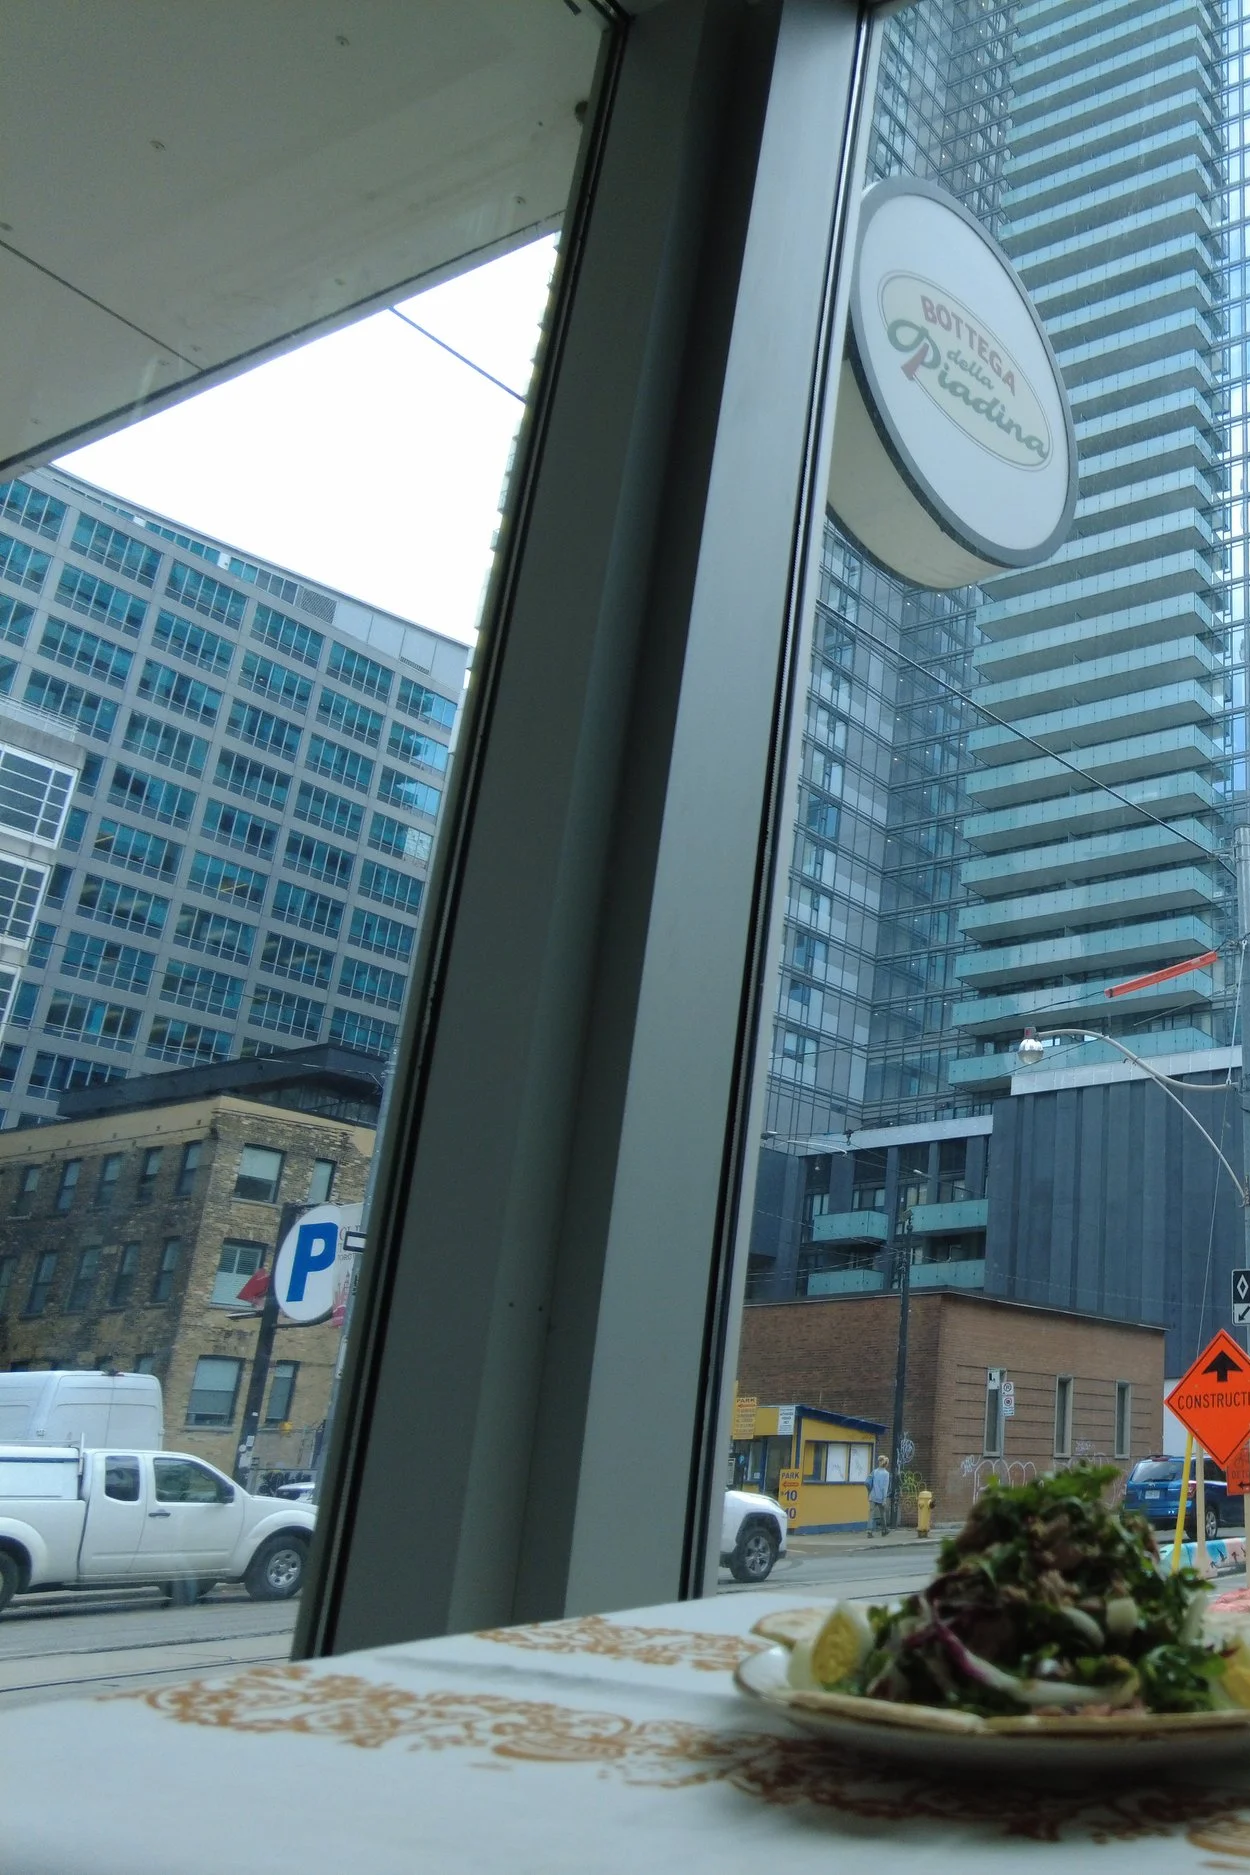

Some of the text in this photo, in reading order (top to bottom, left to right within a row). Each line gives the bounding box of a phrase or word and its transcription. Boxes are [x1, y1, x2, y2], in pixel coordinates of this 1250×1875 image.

[887, 319, 1047, 459] Piadina
[920, 295, 1015, 396] BOTTEGA
[946, 350, 994, 390] della
[286, 1222, 339, 1303] P
